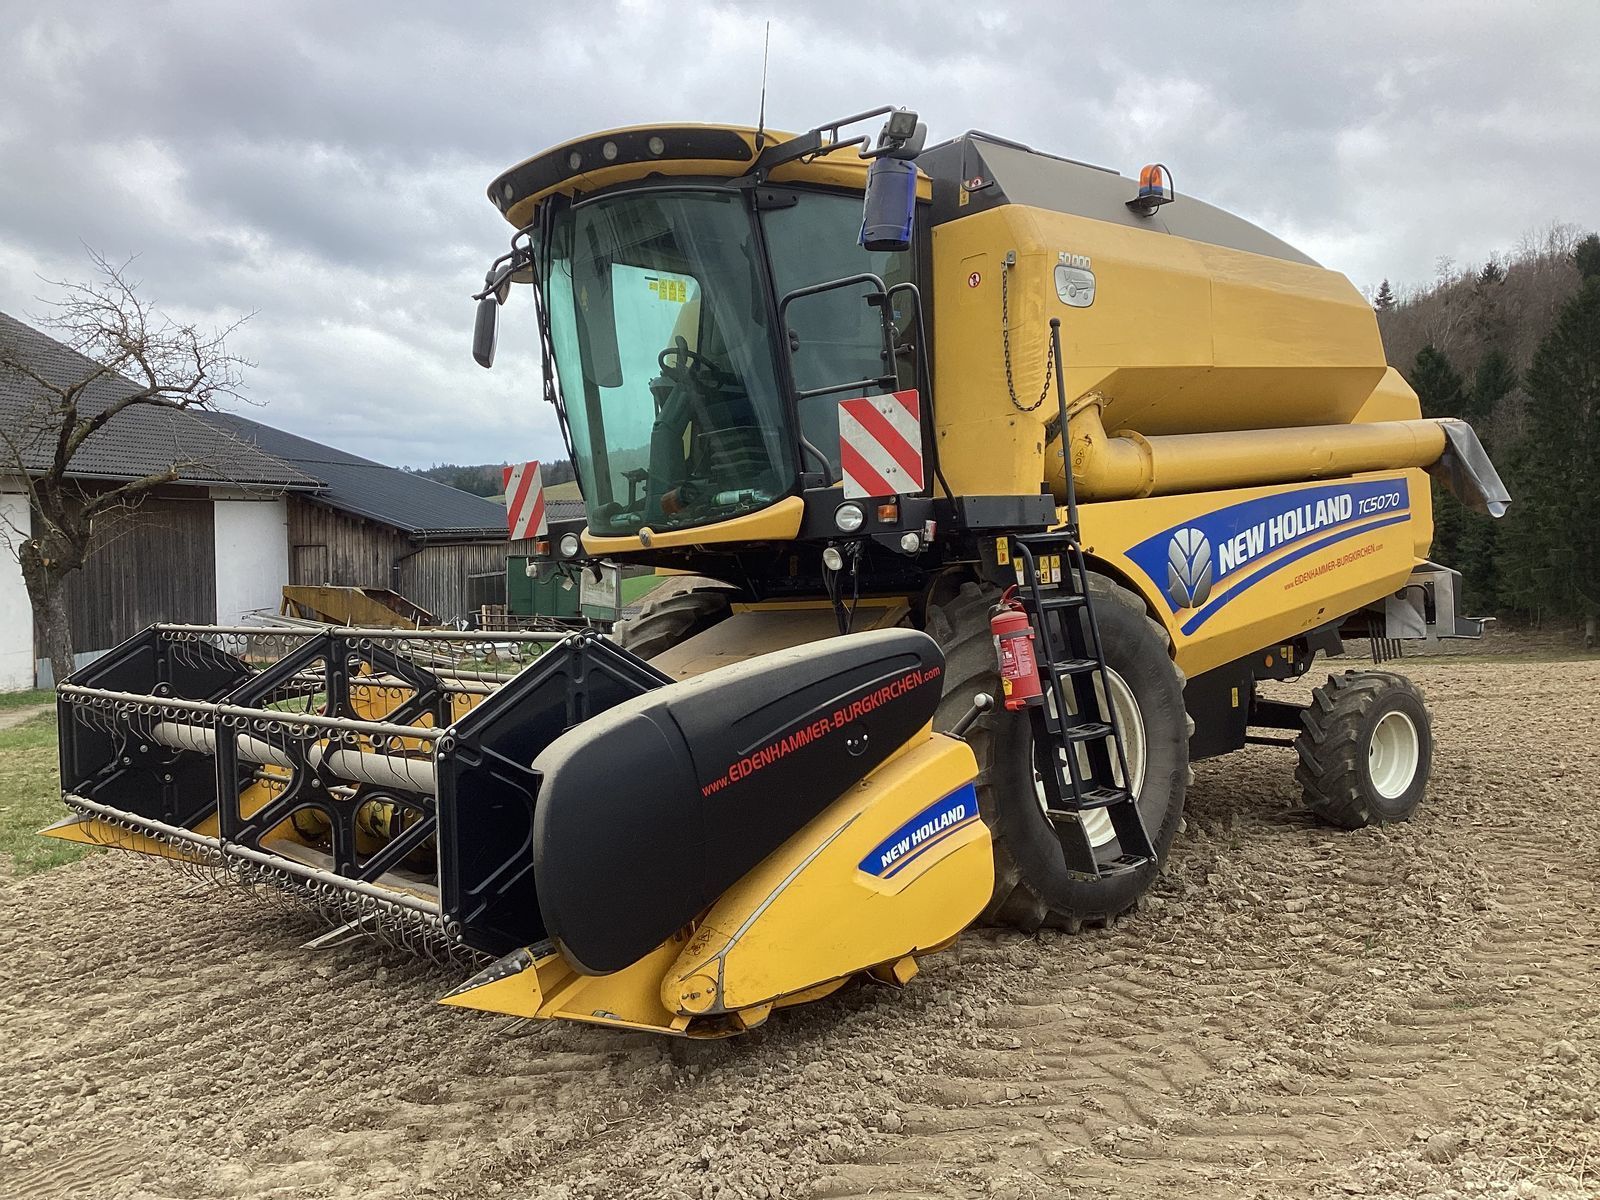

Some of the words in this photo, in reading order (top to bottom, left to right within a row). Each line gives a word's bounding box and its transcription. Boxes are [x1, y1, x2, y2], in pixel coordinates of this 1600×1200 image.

[1219, 523, 1265, 576] NEW
[1270, 494, 1352, 547] HOLLAND
[1358, 492, 1400, 516] TC5070
[701, 666, 941, 797] www.EIDENHAMMER-BURGKIRCHEN.com
[880, 836, 910, 868] NEW
[911, 804, 966, 847] HOLLAND
